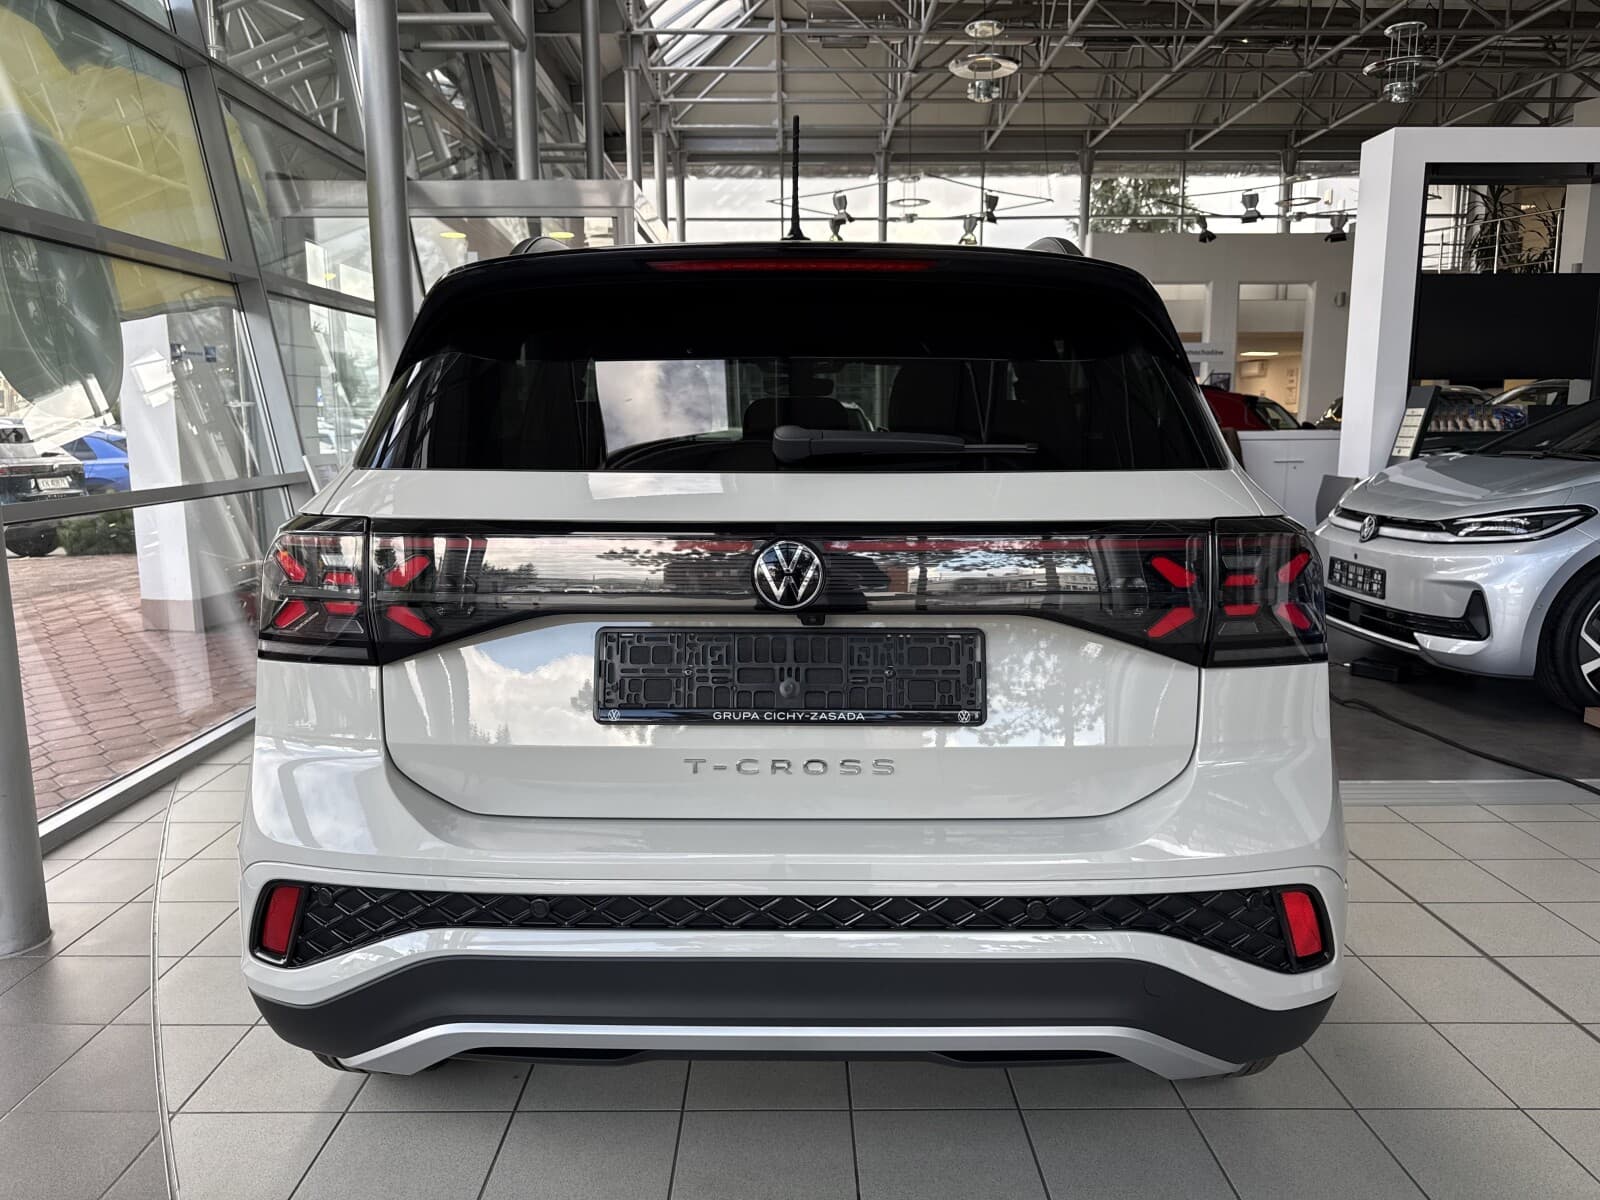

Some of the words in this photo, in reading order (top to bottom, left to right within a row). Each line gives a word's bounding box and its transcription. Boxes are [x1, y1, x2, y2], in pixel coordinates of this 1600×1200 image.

[755, 541, 821, 608] VW
[712, 711, 760, 721] GRUPA
[763, 711, 866, 722] CICHY-ZASADA
[683, 758, 896, 776] T-CROSS
